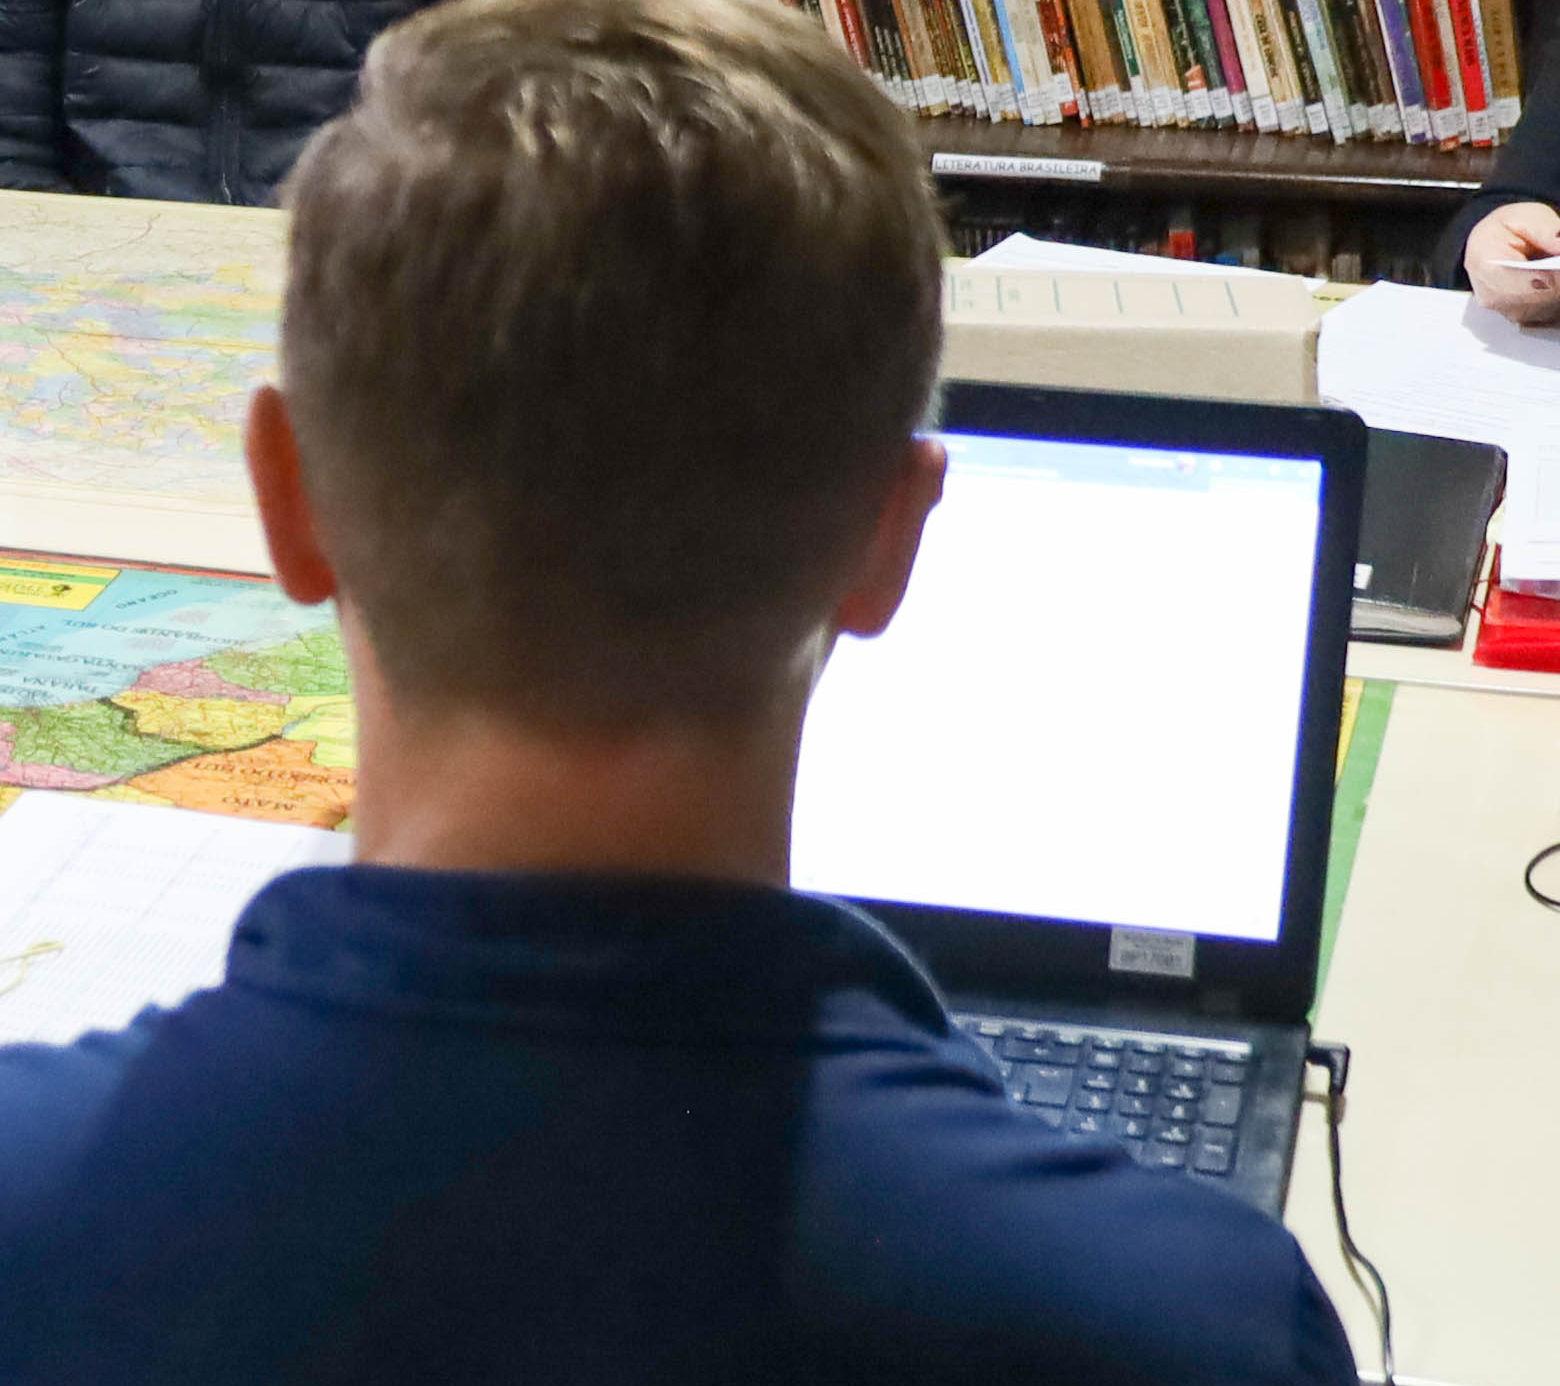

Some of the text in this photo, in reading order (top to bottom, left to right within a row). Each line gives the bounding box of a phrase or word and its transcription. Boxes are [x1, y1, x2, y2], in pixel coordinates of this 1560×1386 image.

[934, 159, 1099, 176] LITERATURA BRASILEIRA
[114, 588, 179, 610] OCEANO
